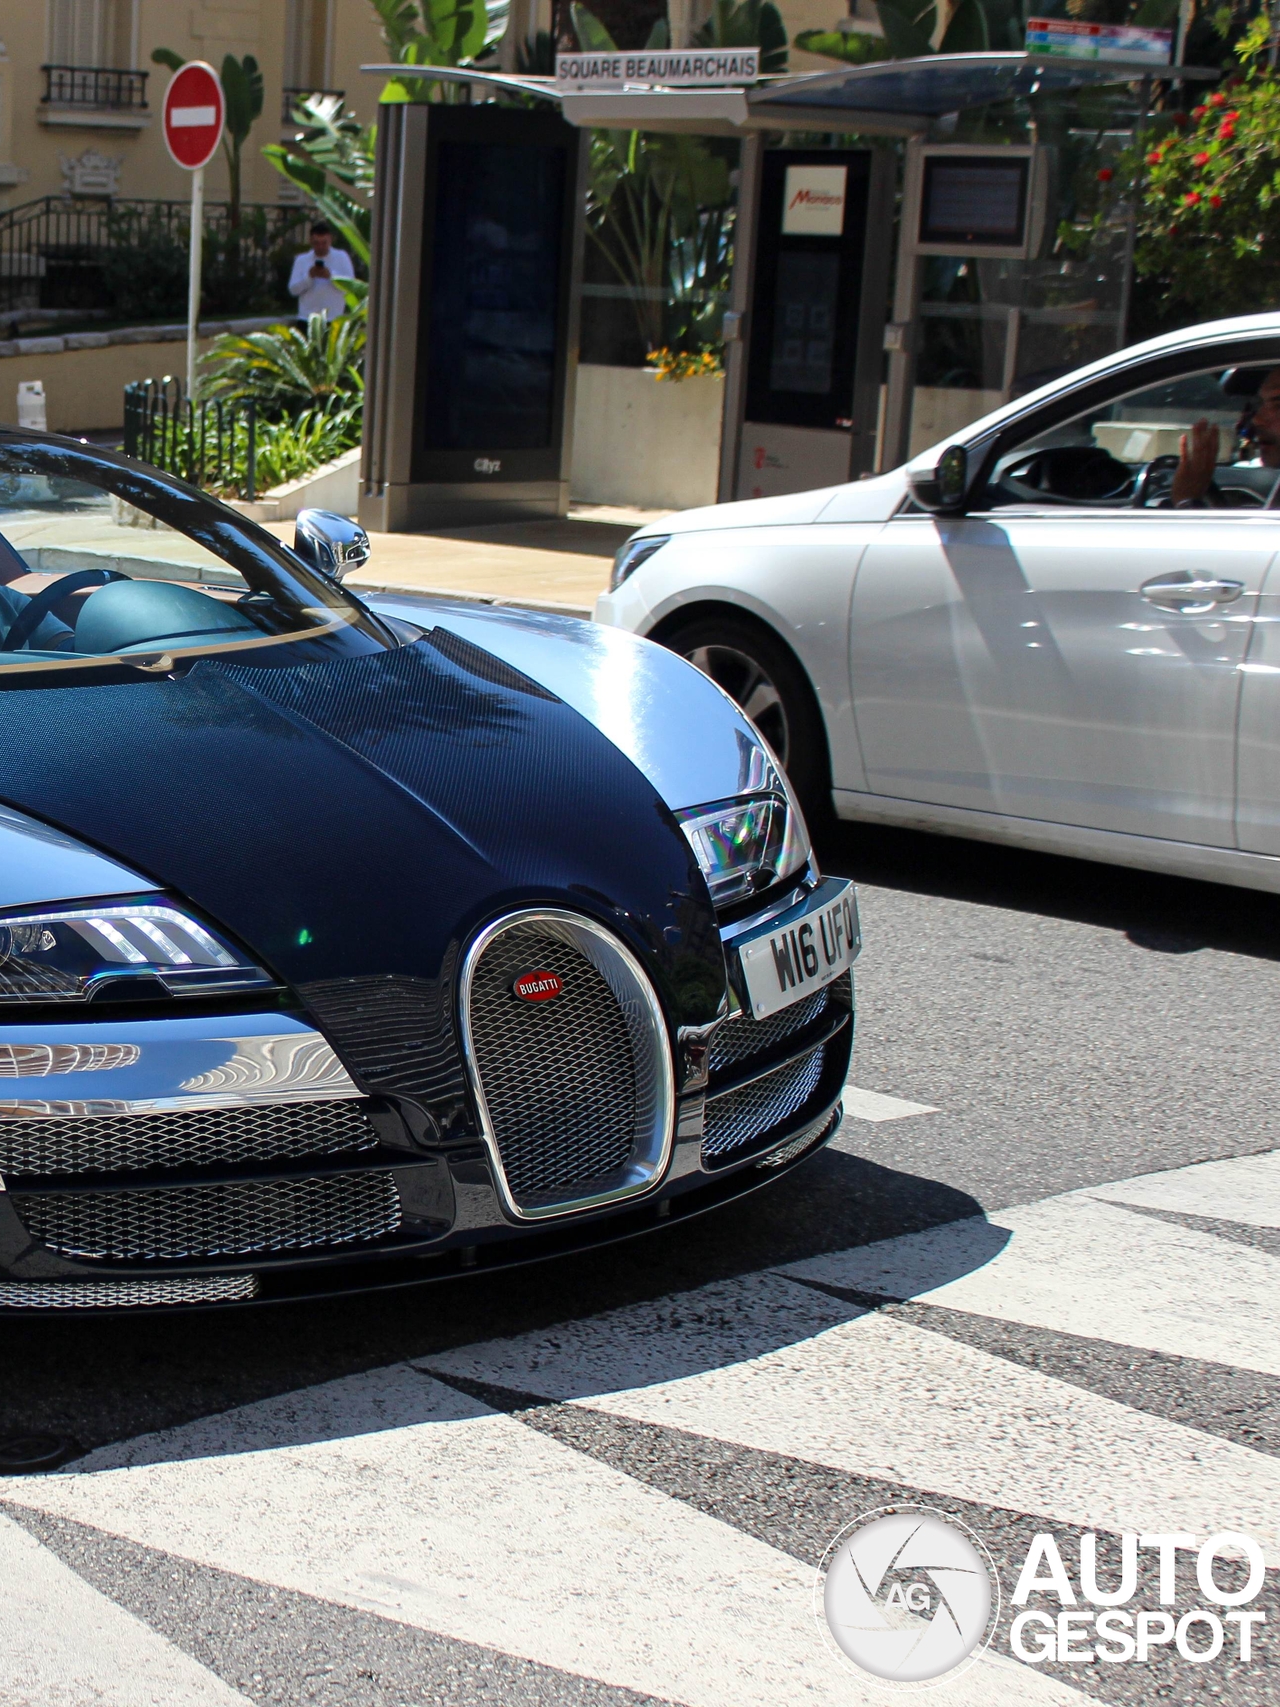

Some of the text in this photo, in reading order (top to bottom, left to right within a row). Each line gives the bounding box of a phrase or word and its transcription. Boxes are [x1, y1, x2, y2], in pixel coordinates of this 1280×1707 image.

[559, 55, 756, 80] SQUARE BEAUMARCHAIS
[770, 897, 854, 992] W16 UFO
[520, 979, 558, 995] BUGATTI
